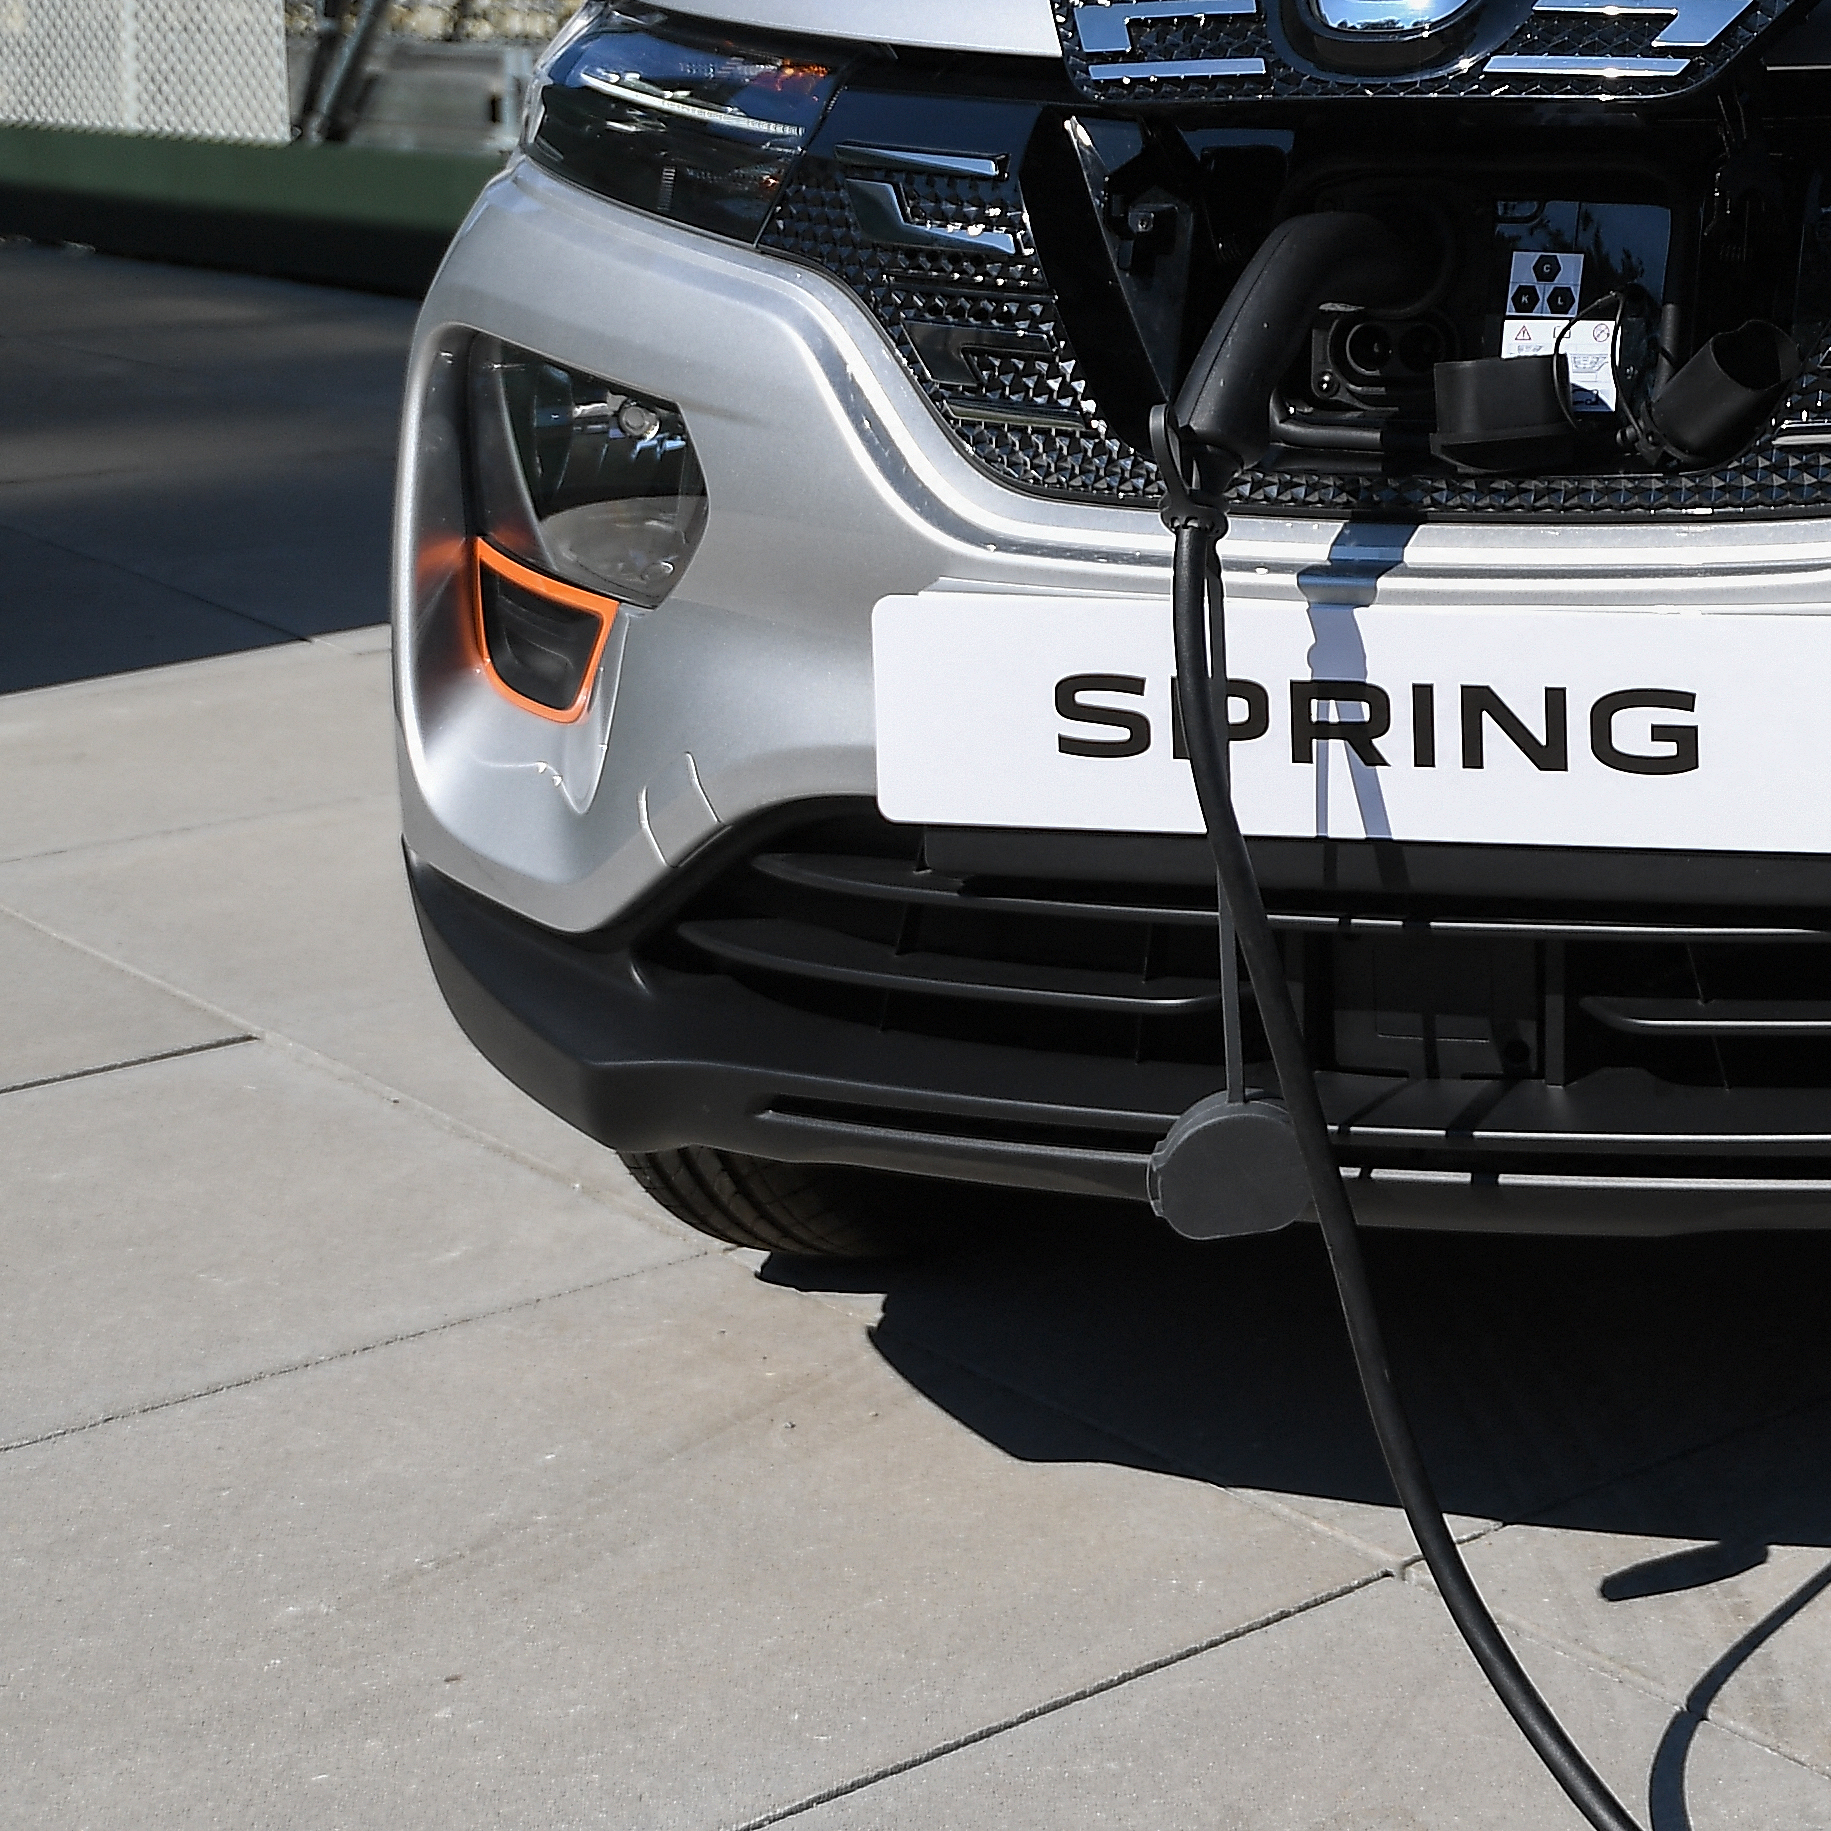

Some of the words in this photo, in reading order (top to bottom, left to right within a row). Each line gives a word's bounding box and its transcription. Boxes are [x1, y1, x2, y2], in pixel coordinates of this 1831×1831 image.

[1543, 264, 1551, 273] C
[1520, 294, 1529, 304] K
[1557, 295, 1564, 305] L
[1054, 672, 1699, 776] SPRING
